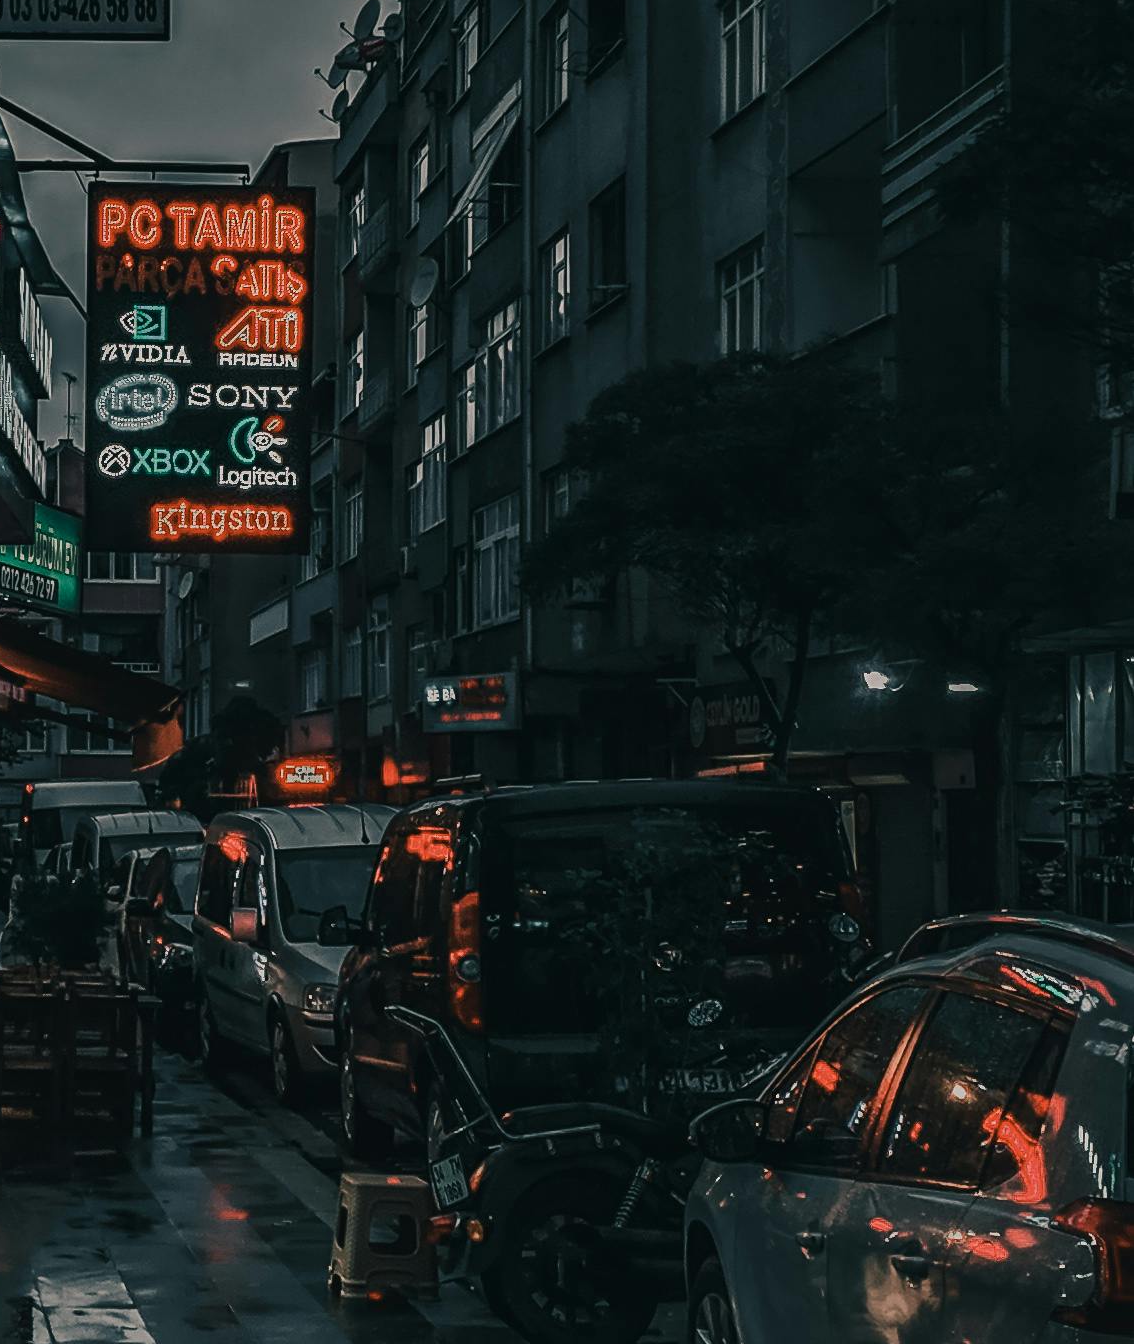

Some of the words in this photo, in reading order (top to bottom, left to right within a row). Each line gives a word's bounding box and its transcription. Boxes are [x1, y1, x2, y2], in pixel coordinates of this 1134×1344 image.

[100, 202, 159, 245] PC
[168, 196, 302, 249] TAMİR
[96, 255, 207, 300] PARÇA
[211, 255, 307, 304] SATIŞ
[218, 307, 301, 350] ATI
[187, 383, 298, 409] SONY
[131, 447, 211, 476] XBOX
[218, 464, 298, 490] Logitech
[154, 501, 292, 537] Kingston
